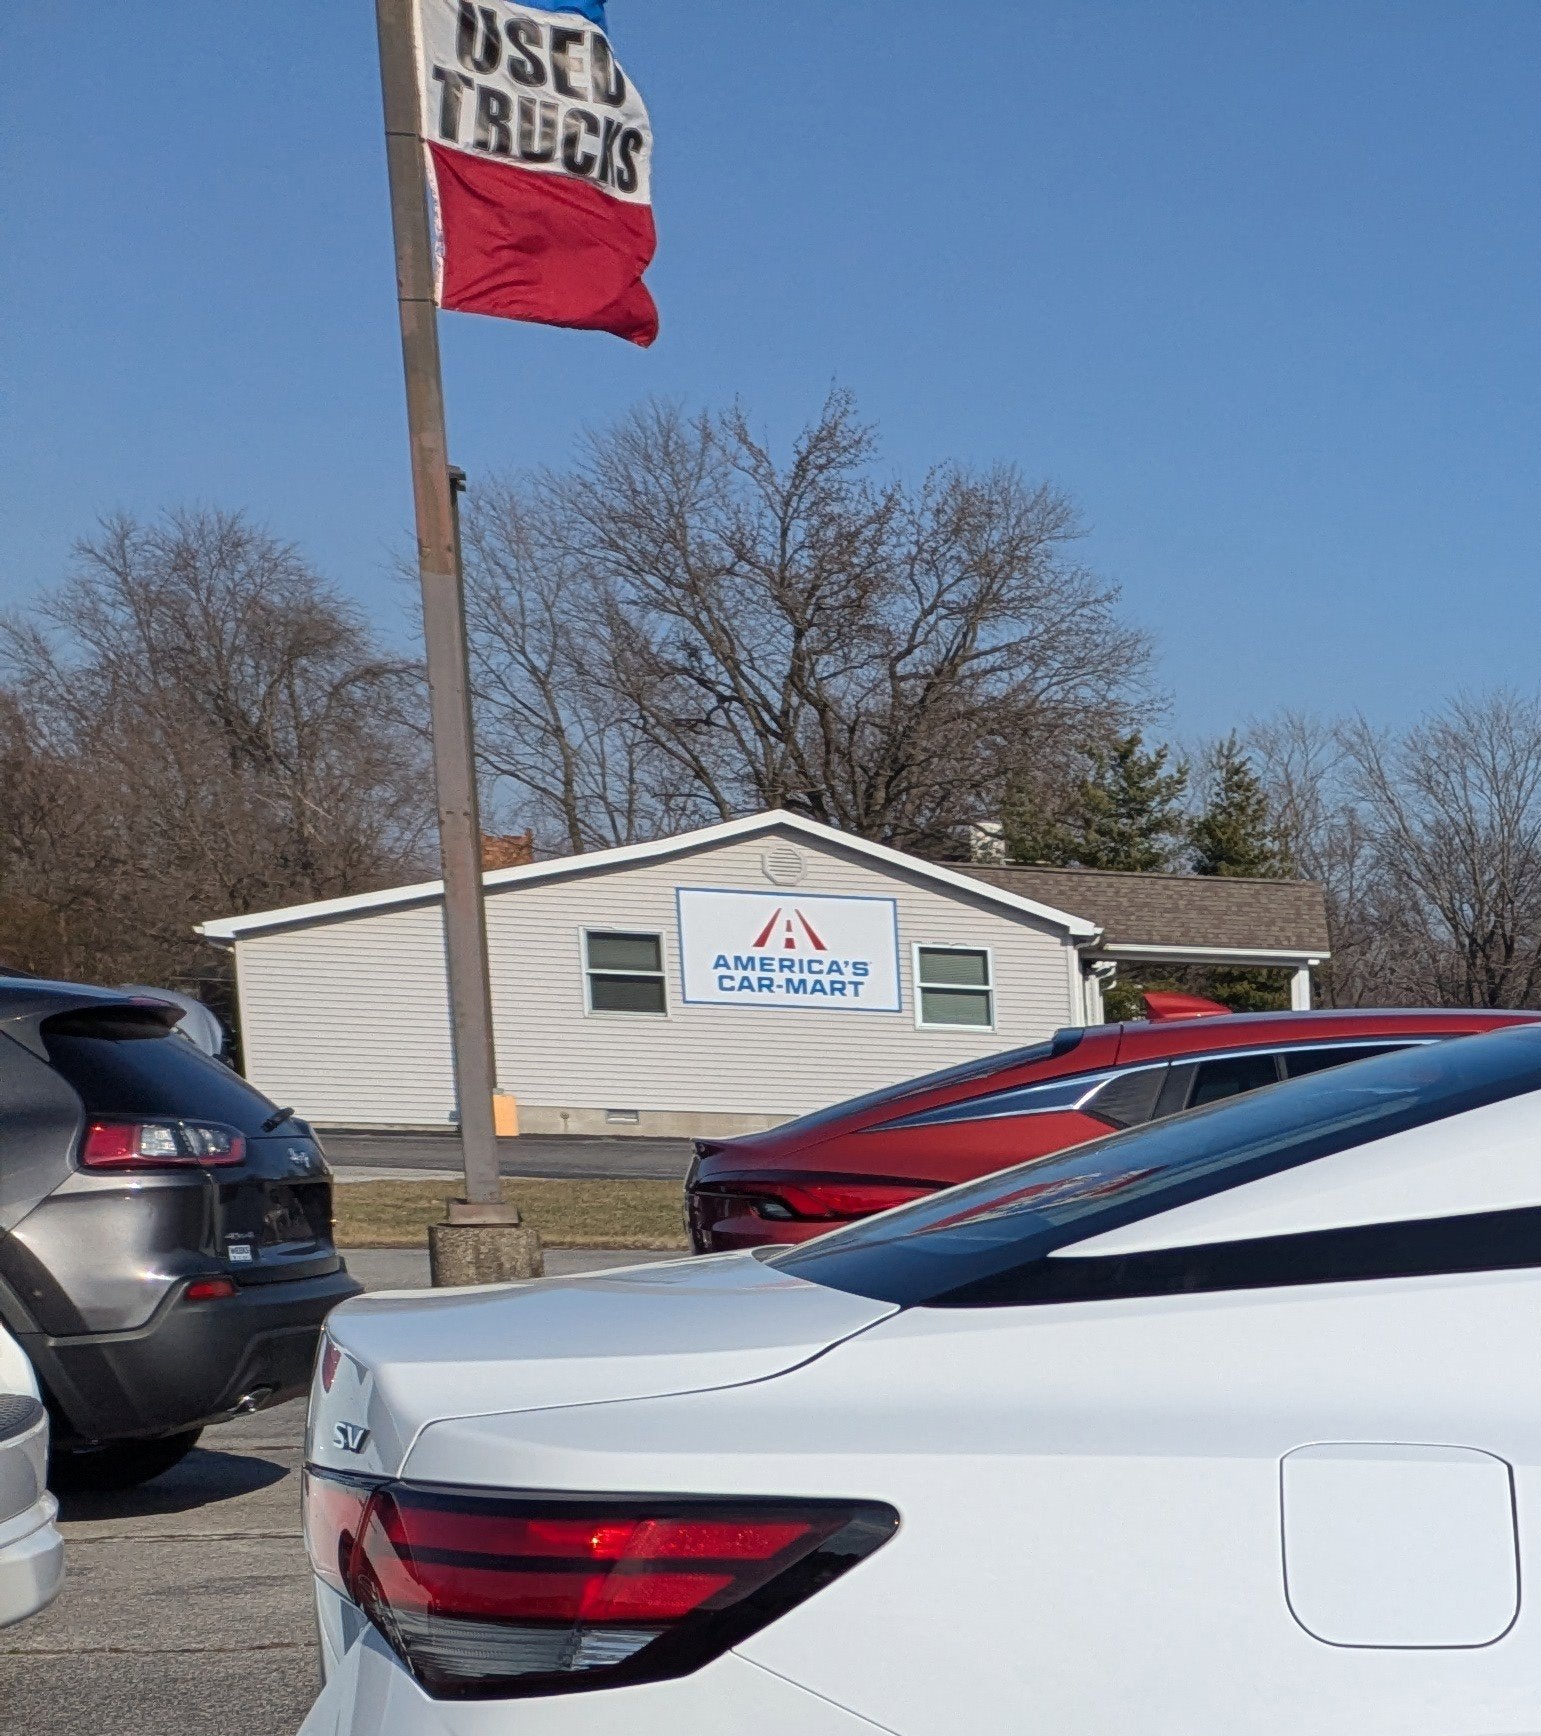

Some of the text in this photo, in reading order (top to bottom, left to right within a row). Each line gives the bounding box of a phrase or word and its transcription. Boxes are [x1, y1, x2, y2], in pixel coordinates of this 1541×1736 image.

[455, 1, 627, 108] USED
[432, 65, 643, 193] TRUCKS
[713, 954, 870, 977] AMERICA'S
[717, 975, 865, 997] CAR-MART
[333, 1421, 369, 1453] SV
